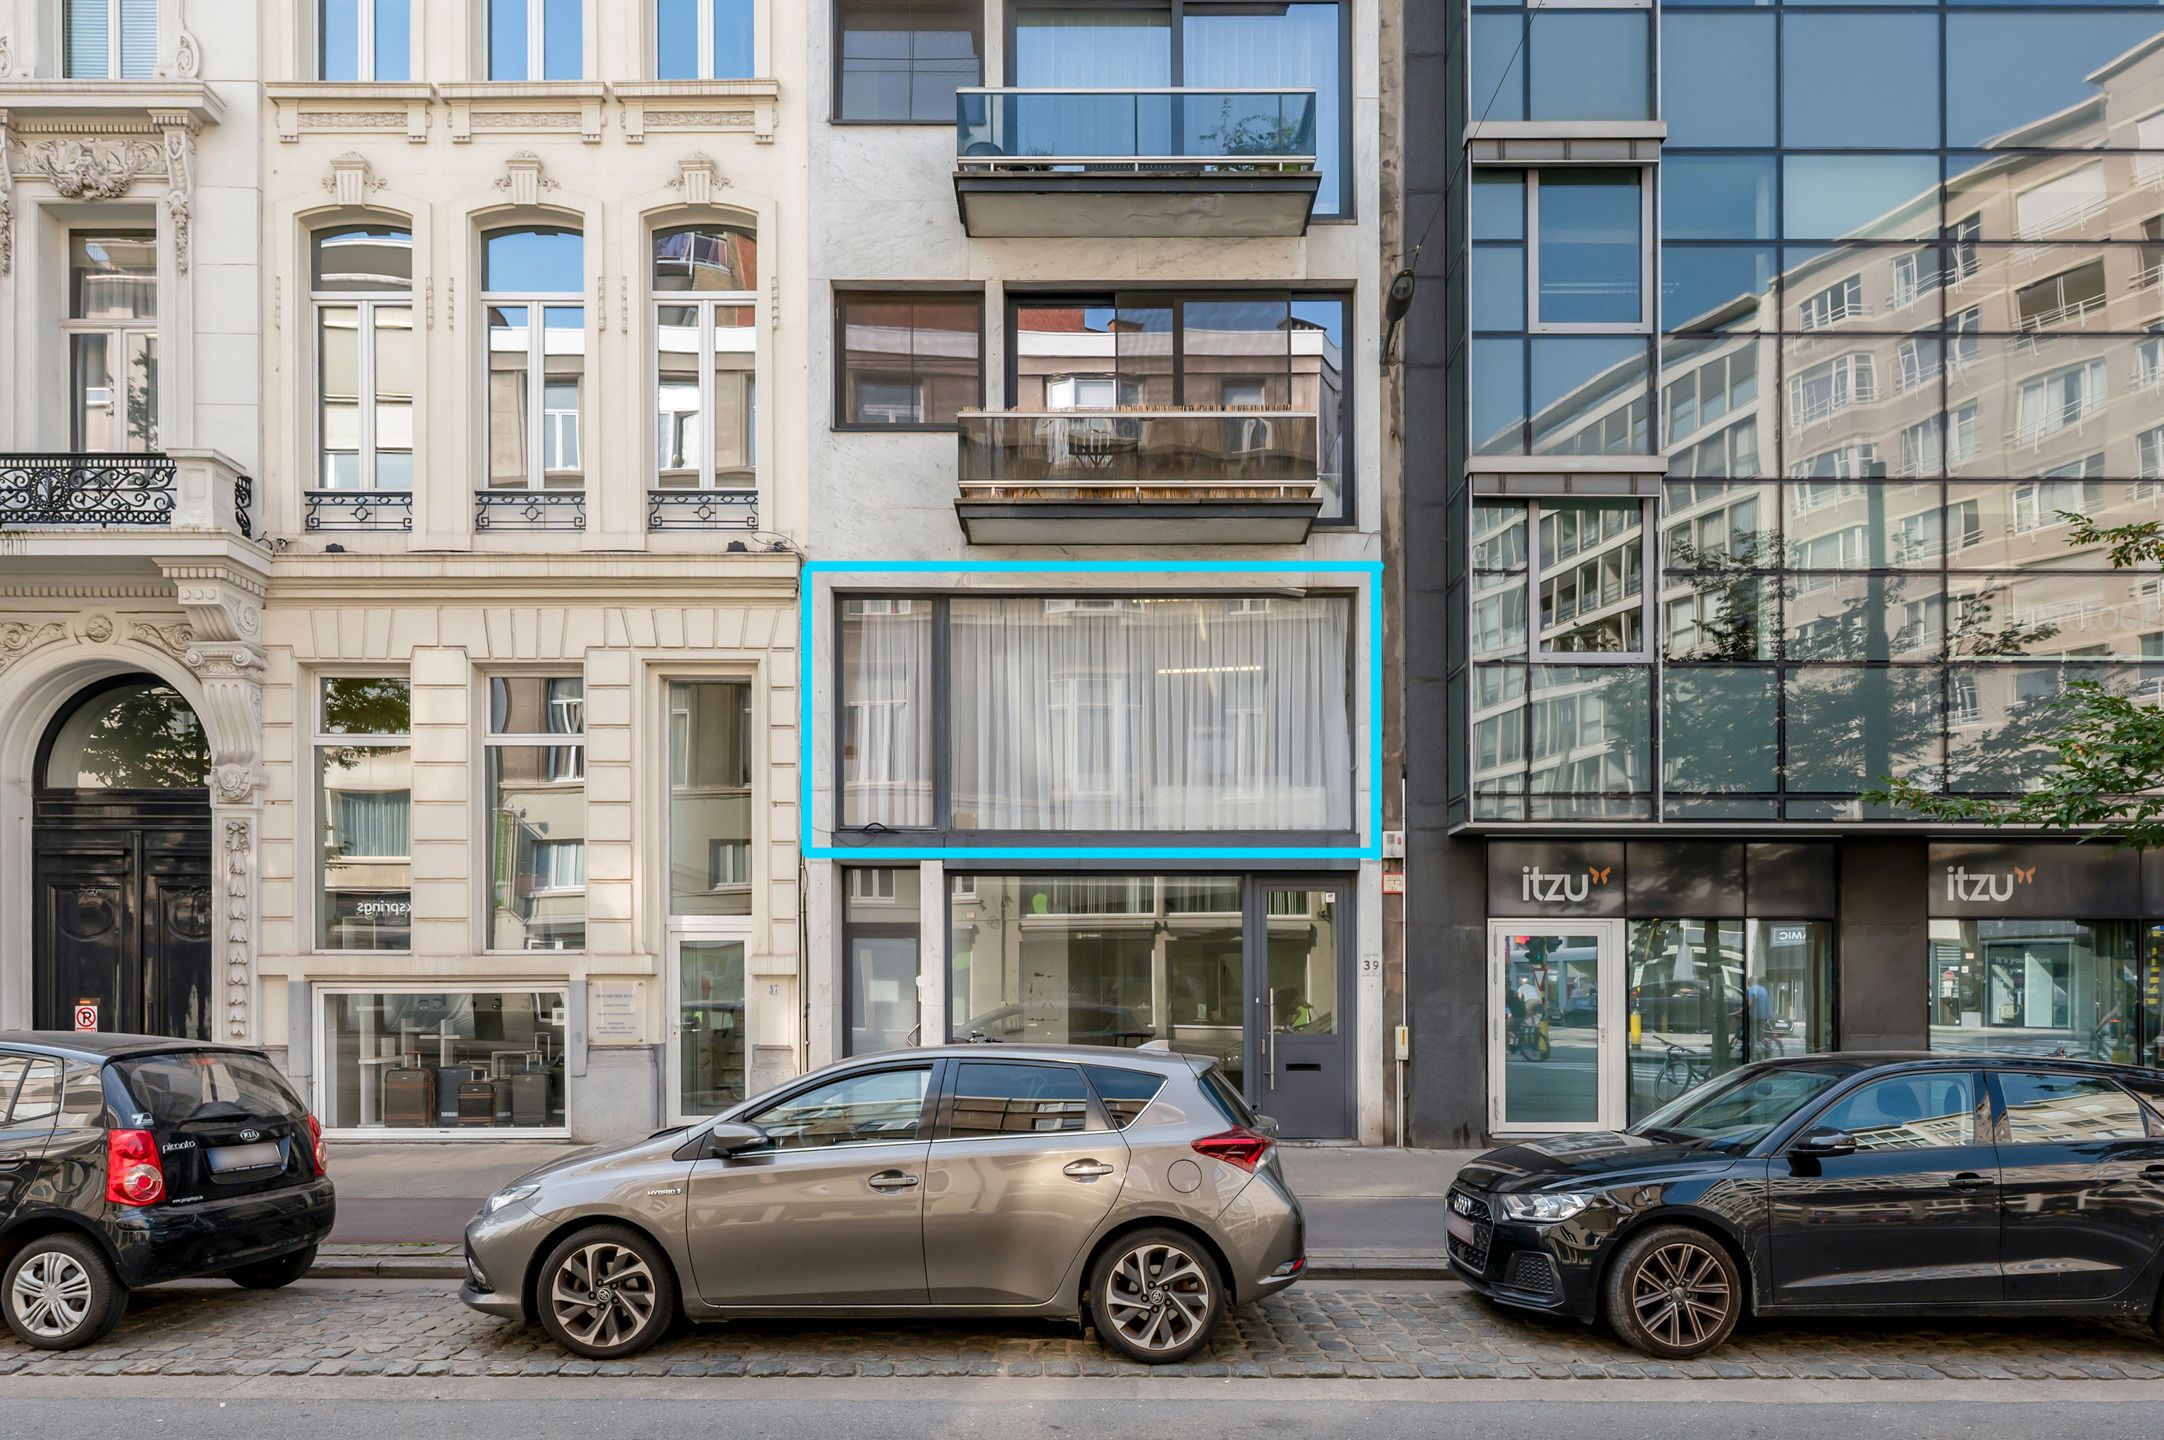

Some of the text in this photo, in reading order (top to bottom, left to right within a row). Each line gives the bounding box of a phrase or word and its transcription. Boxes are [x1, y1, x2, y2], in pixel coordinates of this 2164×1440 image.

[1522, 866, 1588, 901] itzu
[1947, 866, 2013, 901] itzu
[1363, 960, 1379, 971] 39
[162, 1140, 196, 1154] picanto
